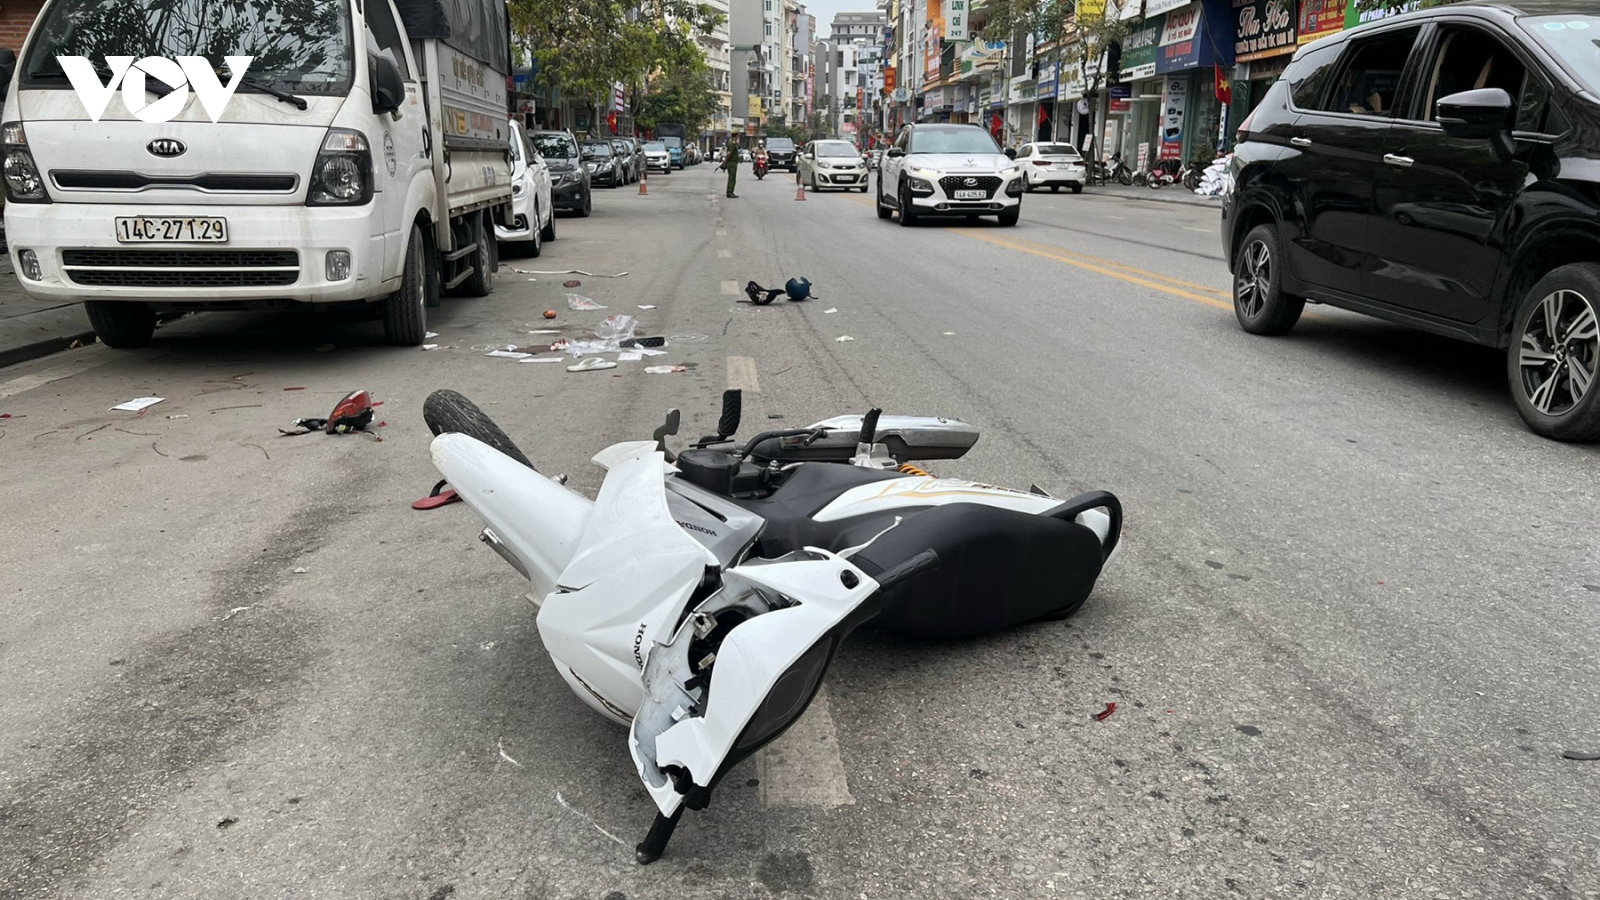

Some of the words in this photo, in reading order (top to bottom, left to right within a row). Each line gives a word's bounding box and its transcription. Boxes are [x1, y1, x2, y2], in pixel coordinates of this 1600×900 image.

[1178, 9, 1197, 28] QUY
[1238, 6, 1260, 38] Thu
[153, 141, 180, 153] KIA
[675, 520, 718, 537] HONDA
